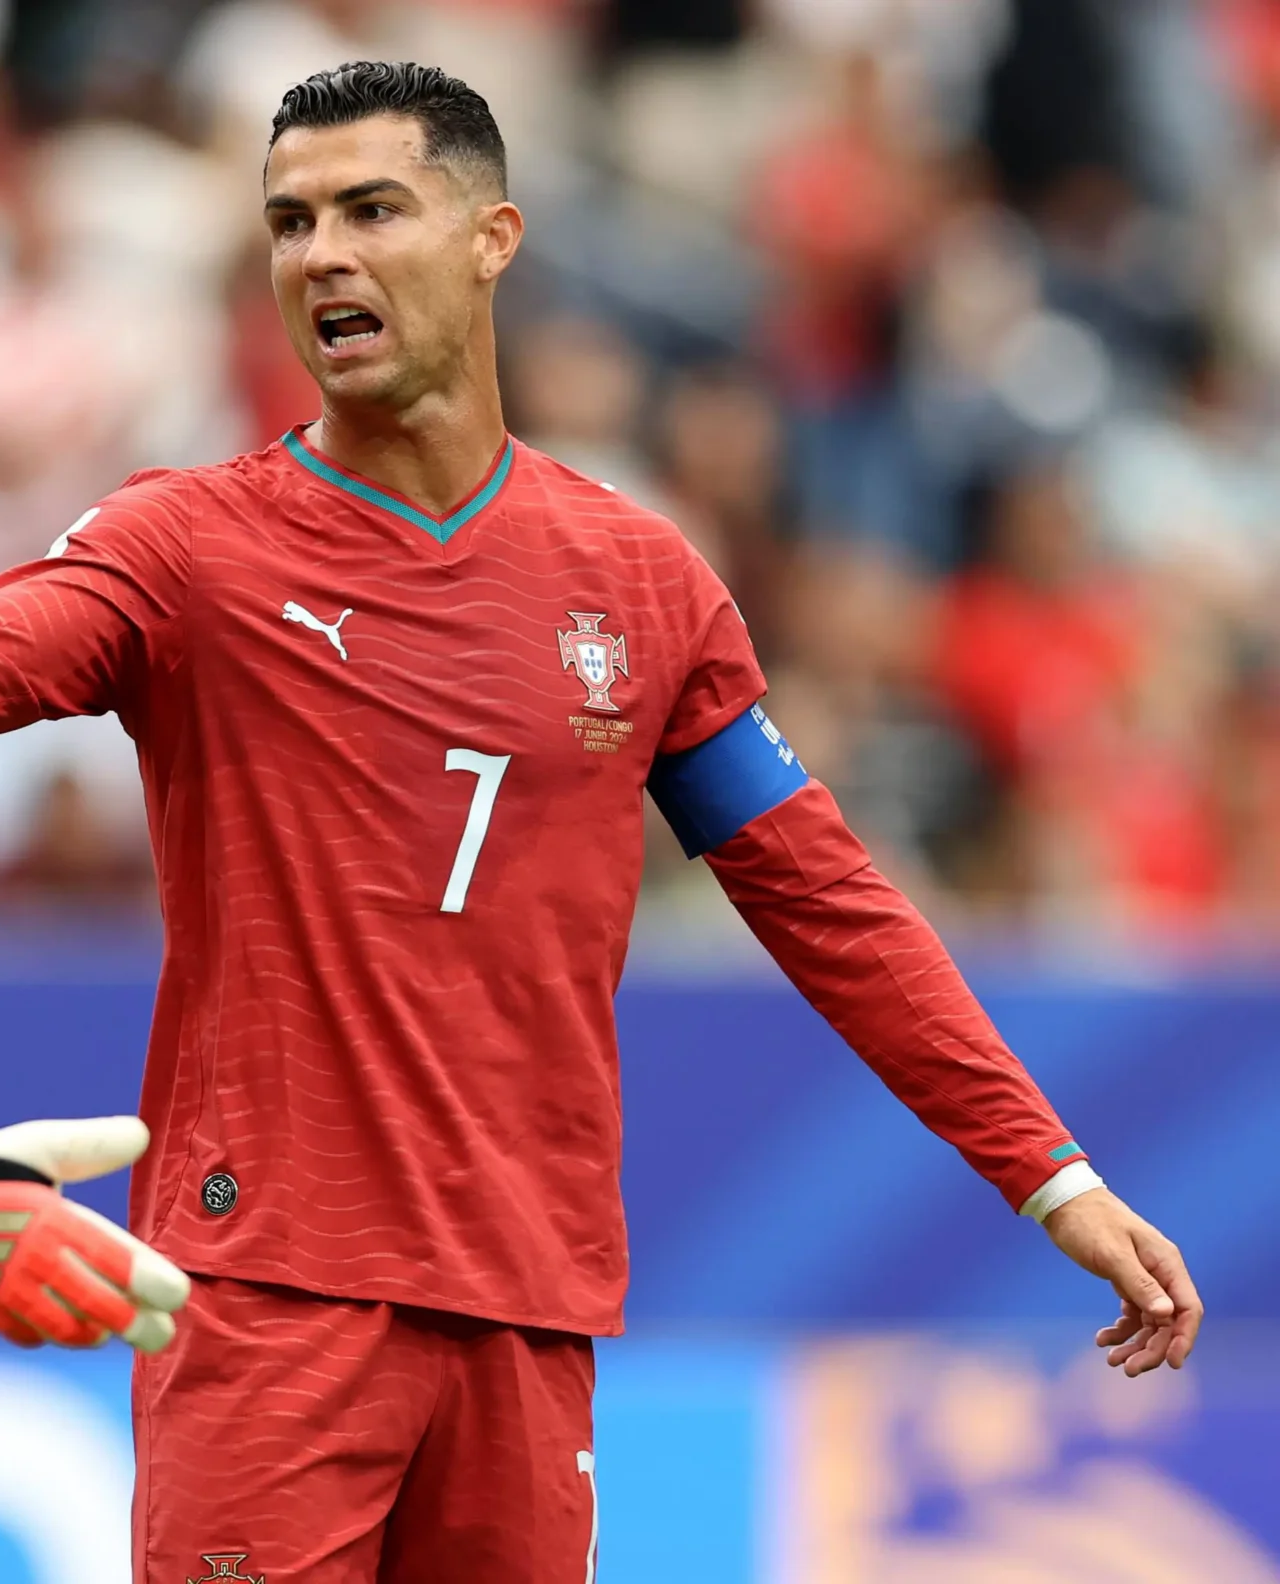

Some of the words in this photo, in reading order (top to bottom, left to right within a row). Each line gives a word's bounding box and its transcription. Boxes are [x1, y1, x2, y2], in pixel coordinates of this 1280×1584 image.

[568, 715, 634, 733] PORTUGAL/CONGO
[574, 728, 582, 738] 17
[584, 729, 608, 741] JUNHO
[583, 740, 619, 754] HOUSTON
[440, 747, 512, 913] 7
